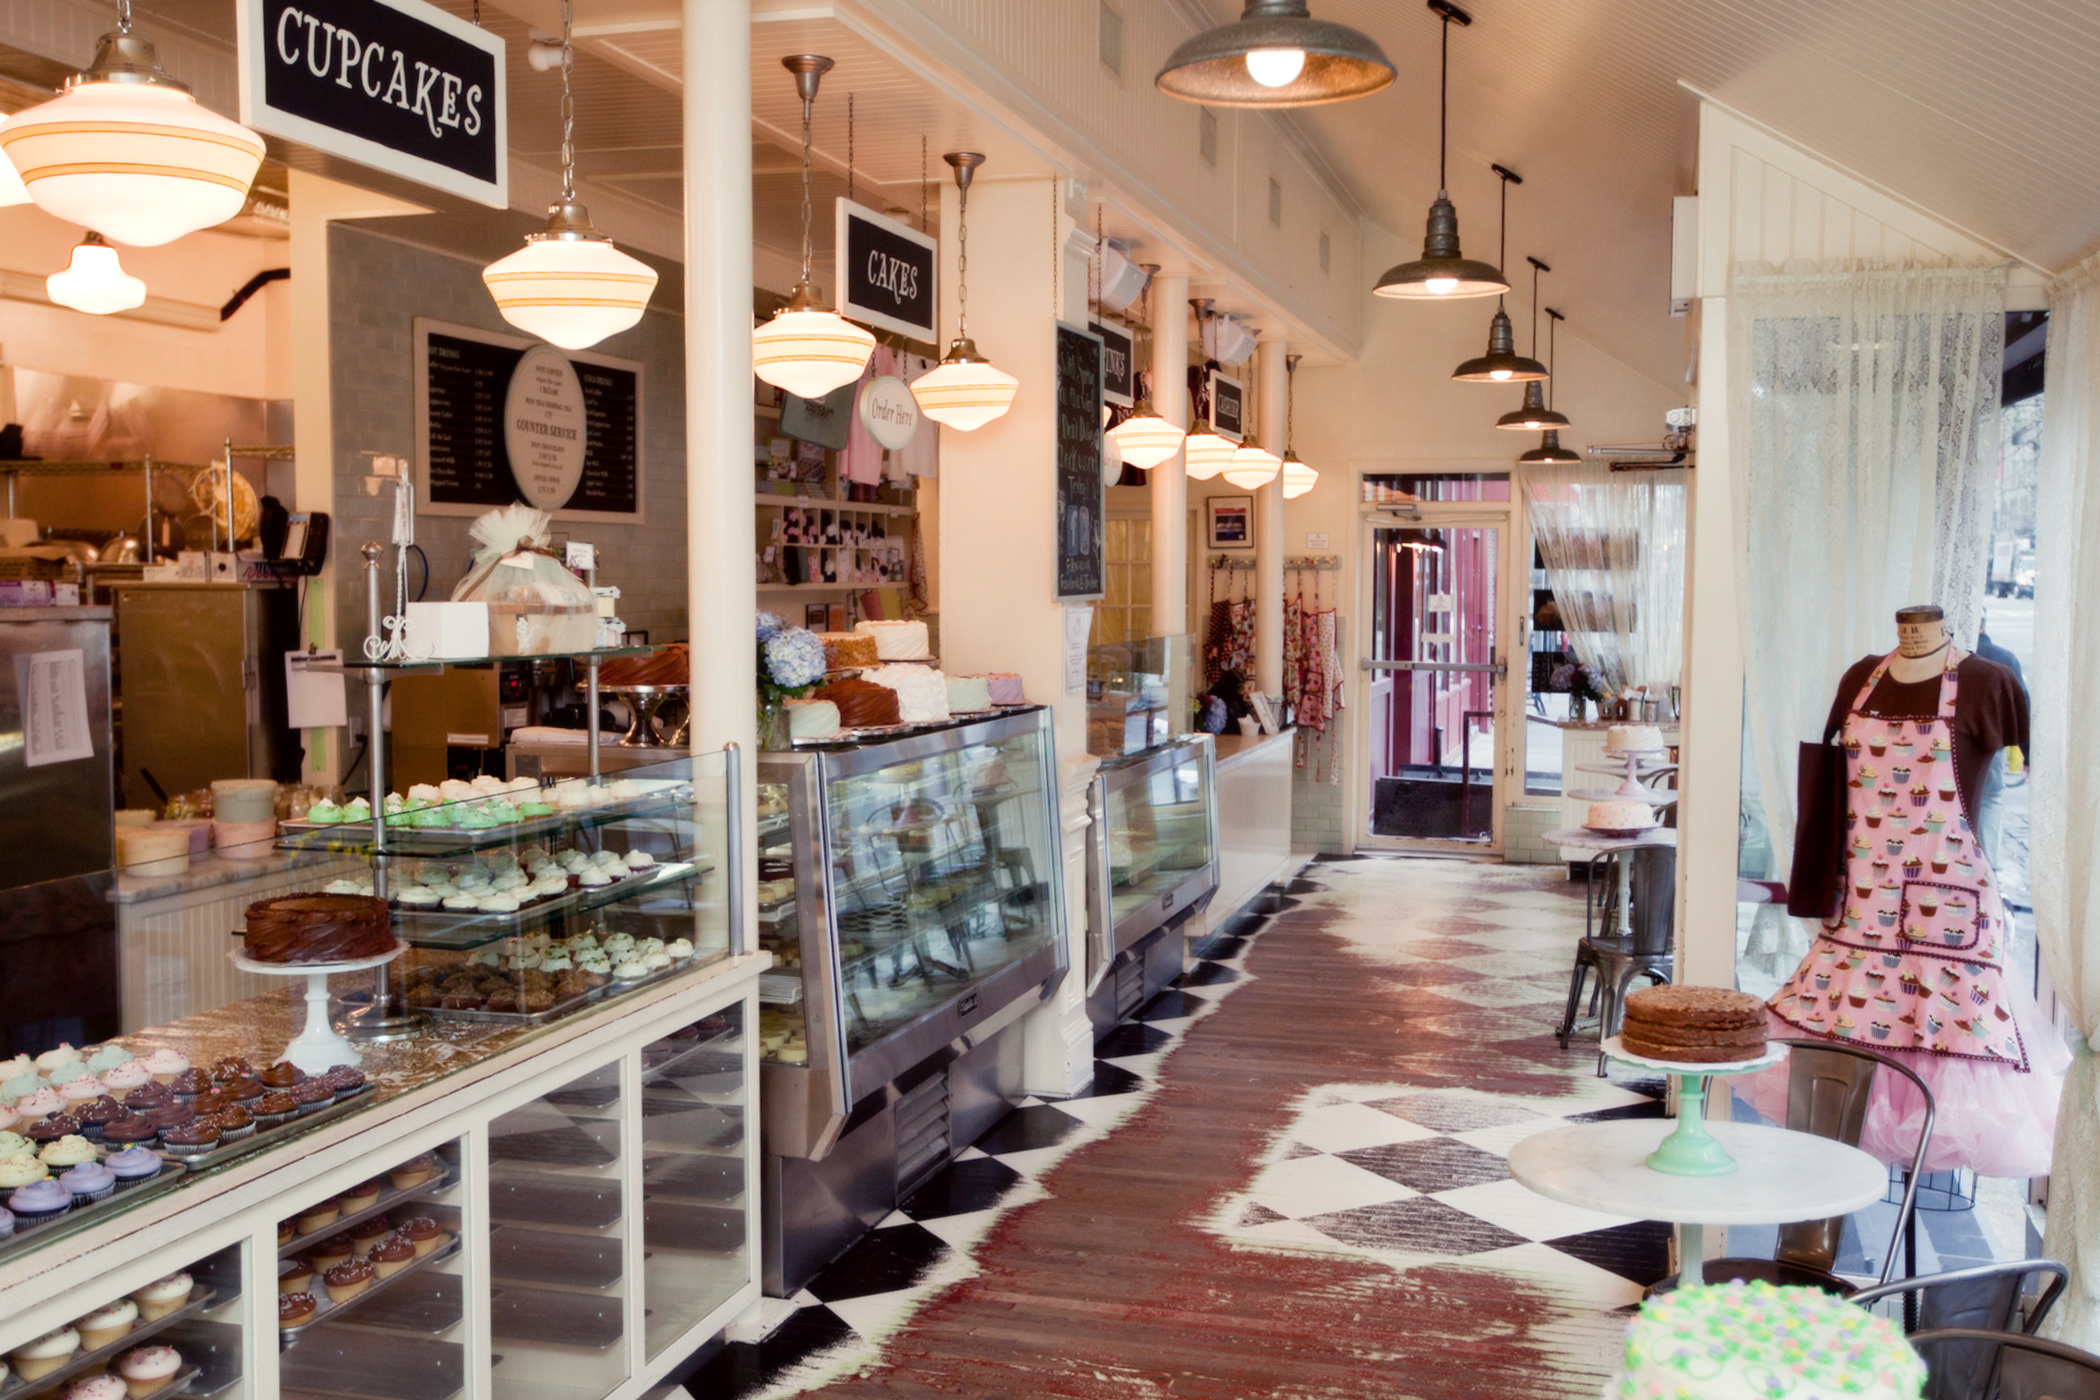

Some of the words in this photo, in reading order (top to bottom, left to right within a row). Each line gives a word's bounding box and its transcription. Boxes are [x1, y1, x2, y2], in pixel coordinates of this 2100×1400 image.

[277, 7, 483, 138] CUPCAKES
[868, 250, 918, 304] CAKES
[516, 418, 549, 436] COUNTER
[549, 425, 577, 441] SERVICE
[872, 398, 894, 421] Order
[896, 404, 913, 427] Here
